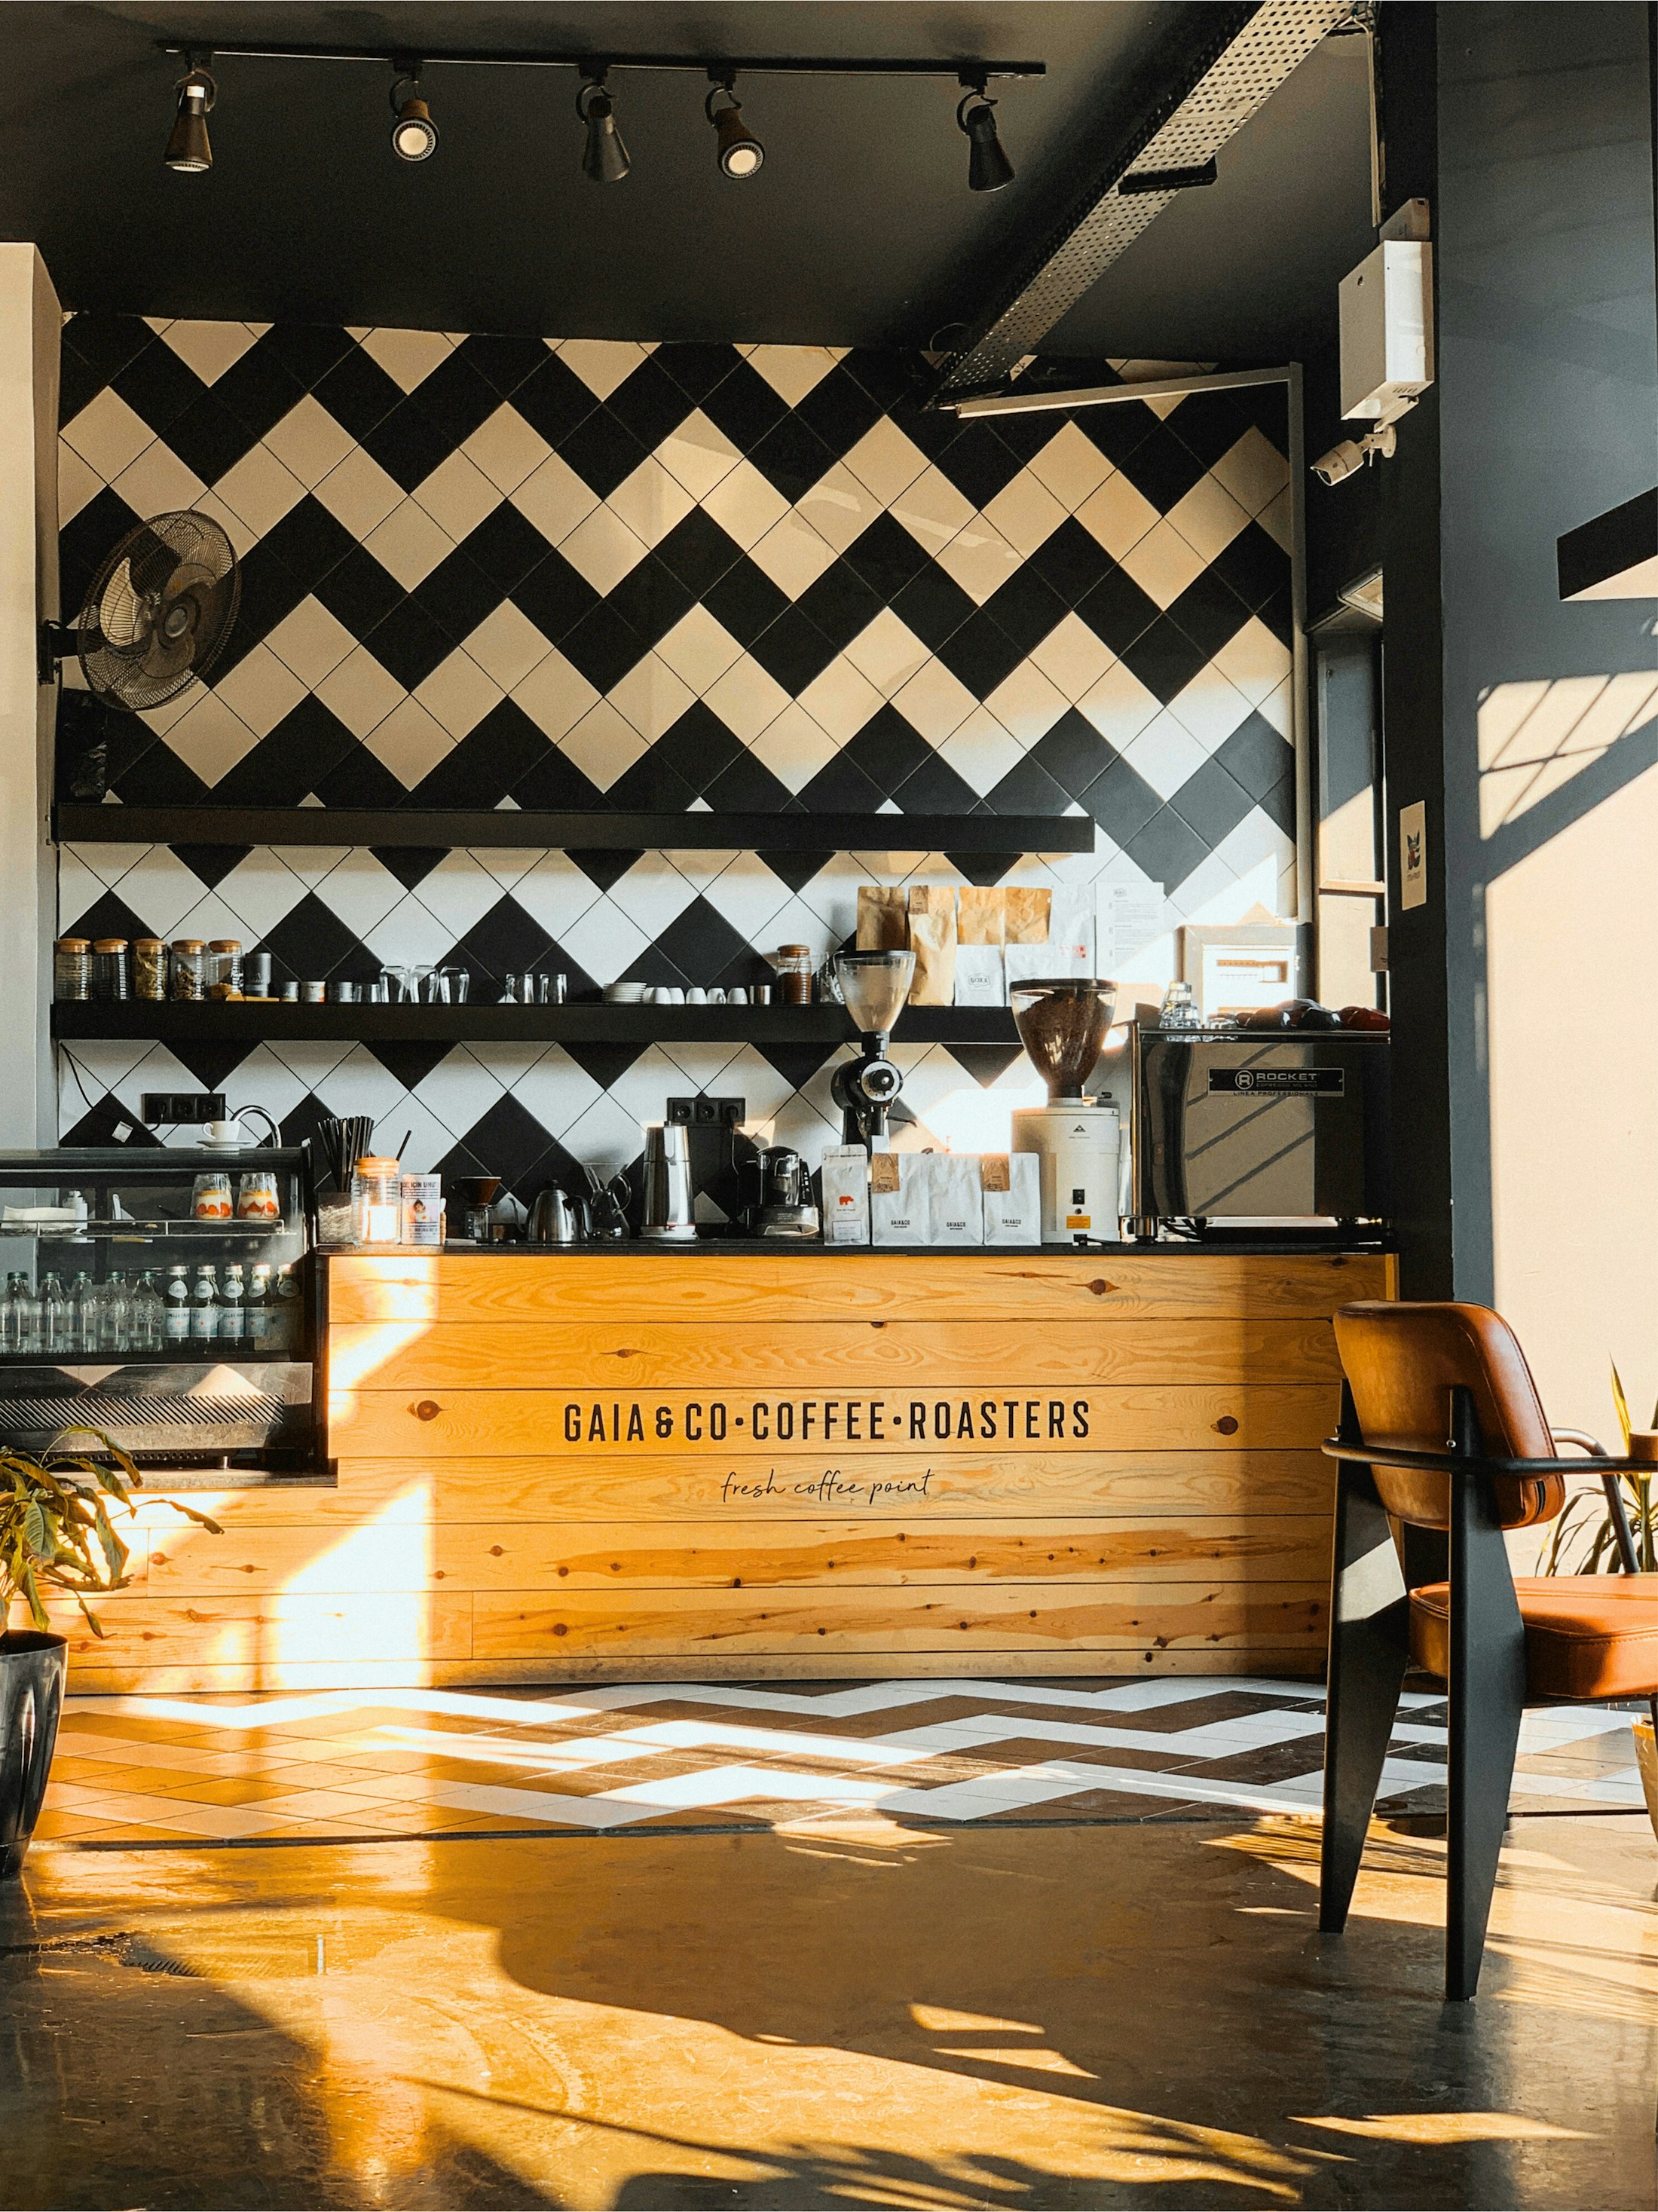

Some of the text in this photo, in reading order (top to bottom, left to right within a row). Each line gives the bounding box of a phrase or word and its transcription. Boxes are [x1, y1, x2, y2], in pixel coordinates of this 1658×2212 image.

[1256, 1072, 1318, 1081] ROCKET
[752, 1402, 885, 1440] COFFEE
[910, 1400, 1089, 1439] ROASTERS
[720, 1468, 935, 1505] fresh coffee point
